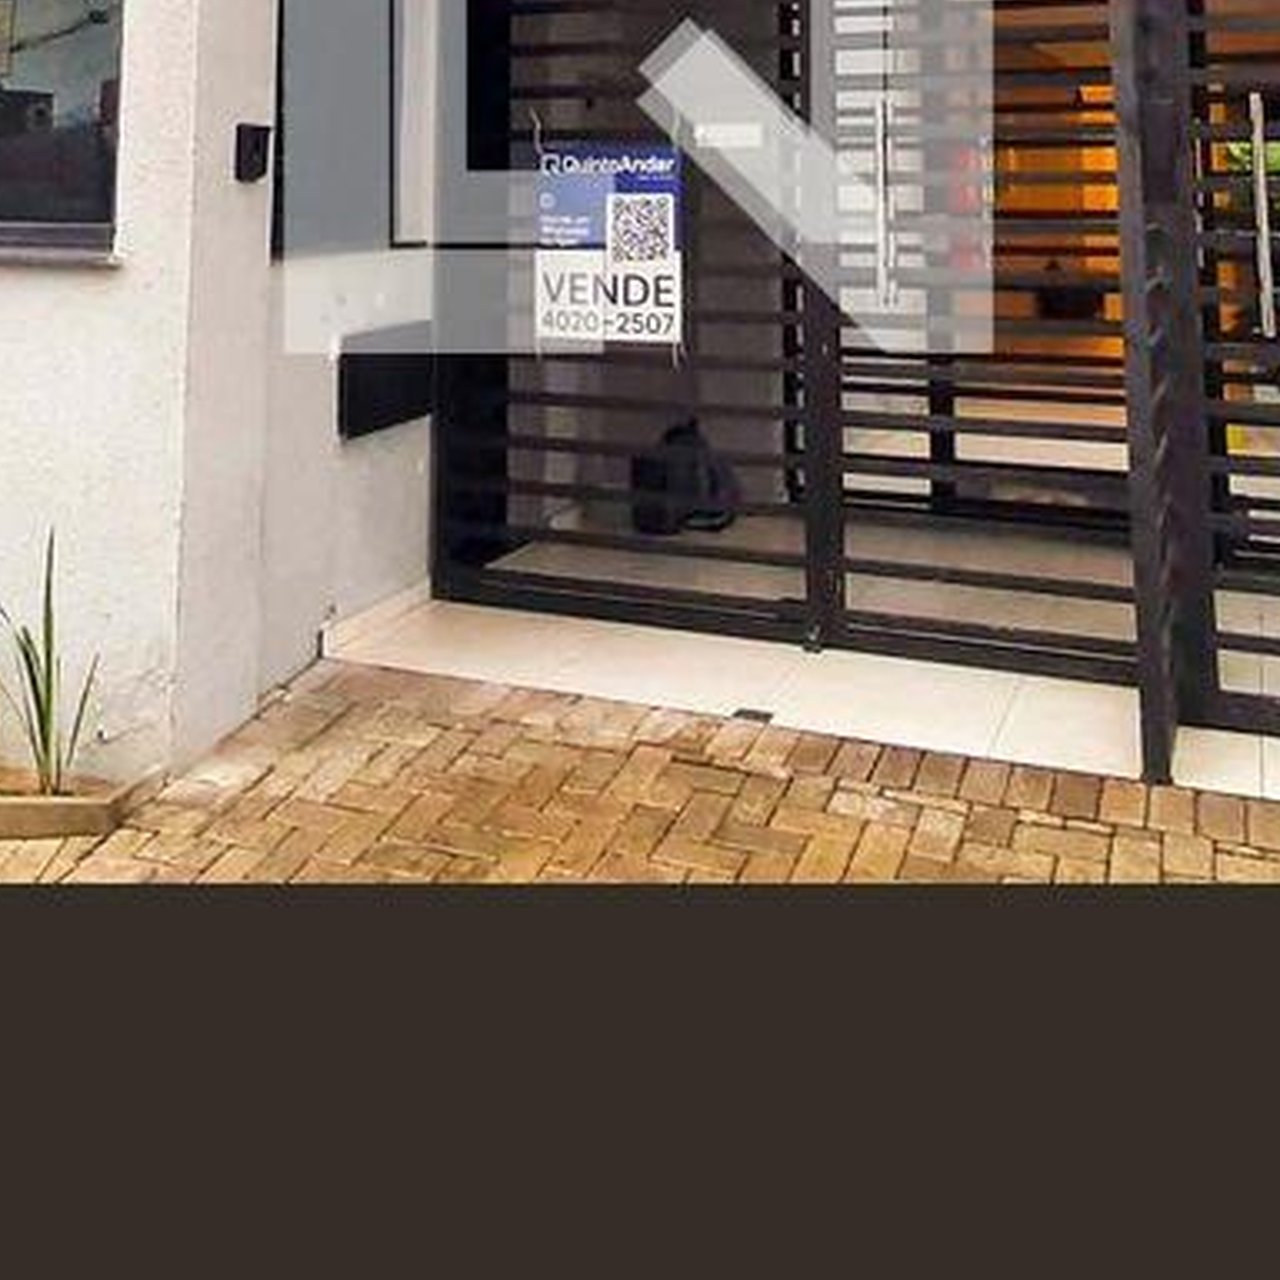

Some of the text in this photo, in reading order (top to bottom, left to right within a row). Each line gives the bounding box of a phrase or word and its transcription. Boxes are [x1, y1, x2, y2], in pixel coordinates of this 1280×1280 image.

[561, 154, 675, 173] QuintoAndar
[542, 272, 674, 308] VENDE
[541, 311, 675, 334] 4020-2507
